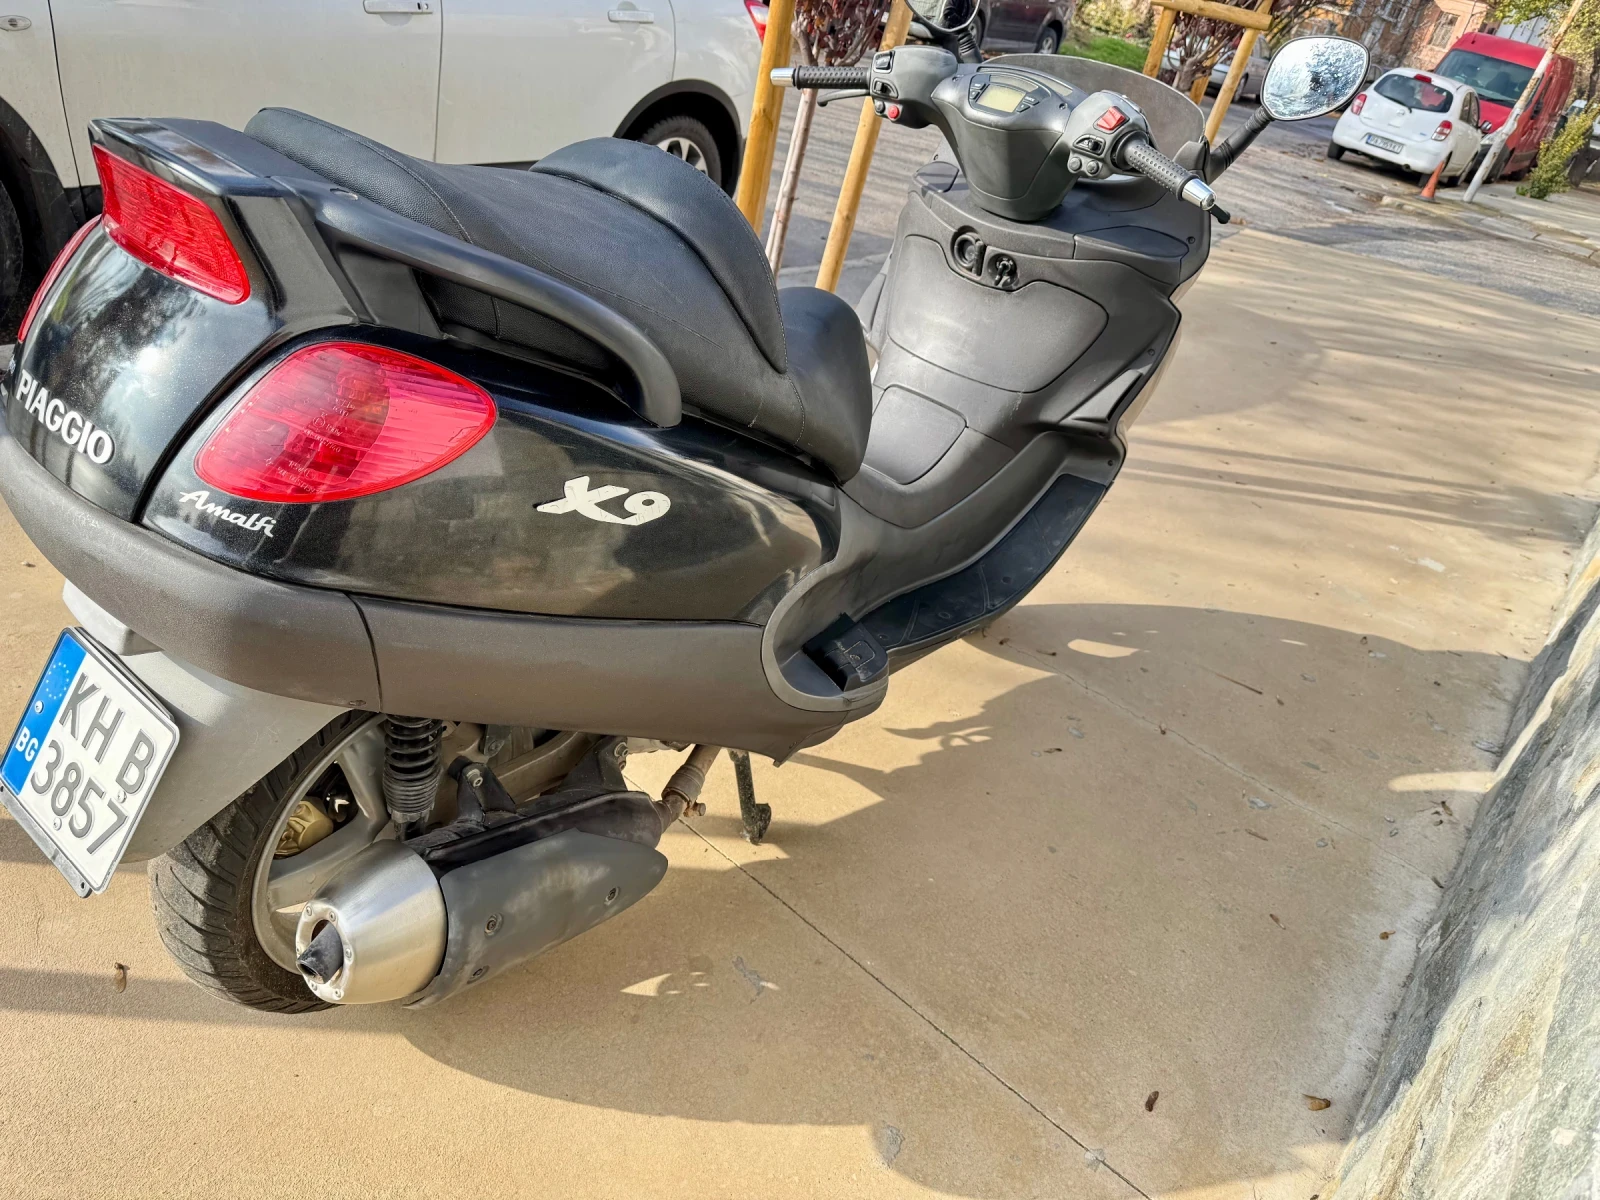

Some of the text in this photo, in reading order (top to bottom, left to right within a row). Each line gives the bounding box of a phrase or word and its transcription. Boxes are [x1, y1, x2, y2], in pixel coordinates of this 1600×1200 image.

[16, 369, 114, 464] PIAGGIO
[179, 490, 277, 538] Amalfi
[536, 475, 672, 526] X9
[15, 727, 39, 762] BG
[30, 739, 128, 855] 3857
